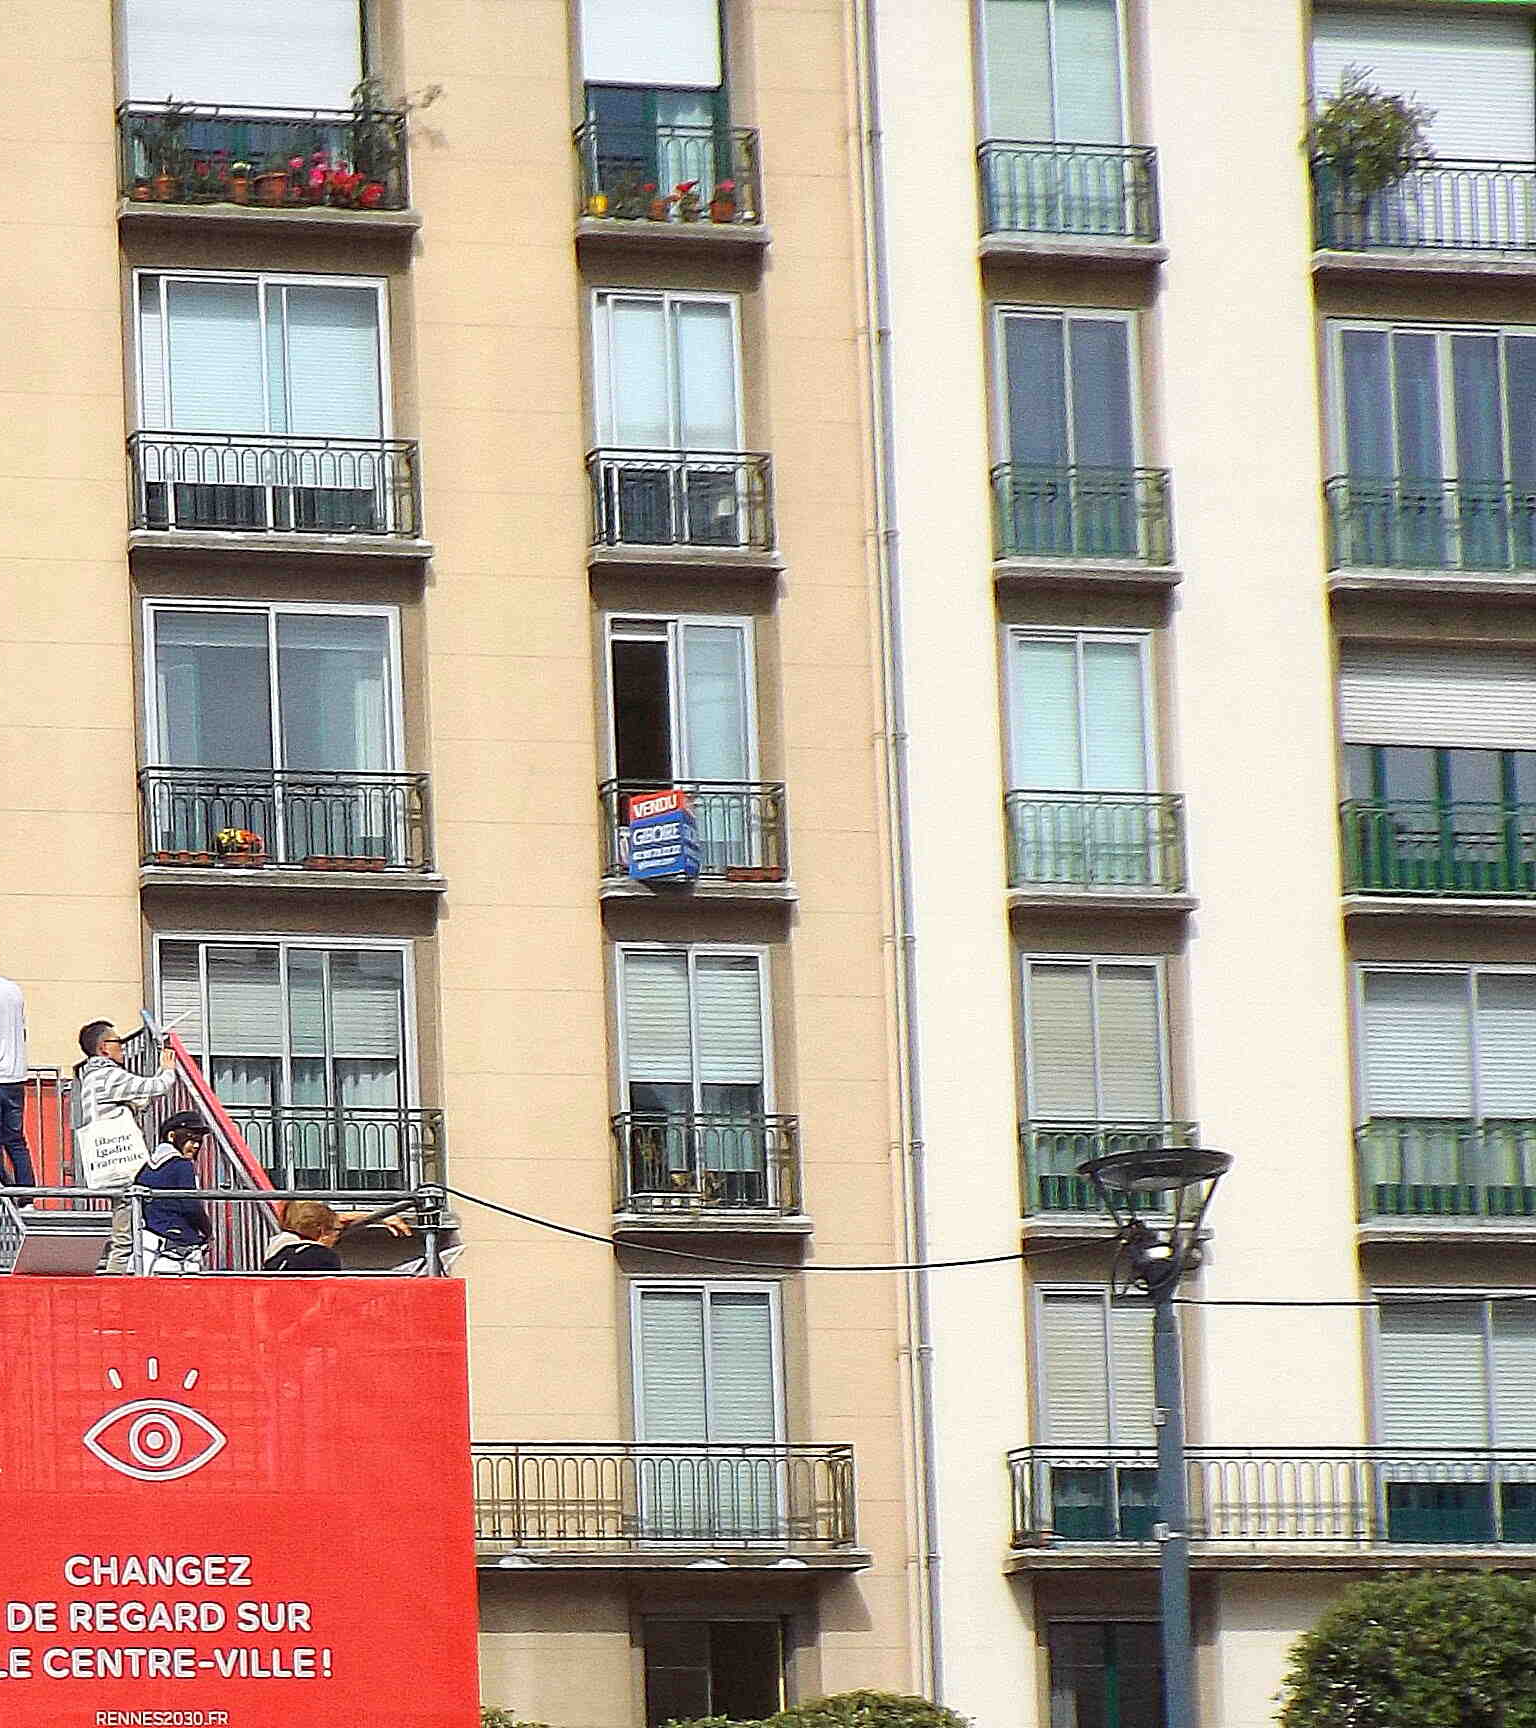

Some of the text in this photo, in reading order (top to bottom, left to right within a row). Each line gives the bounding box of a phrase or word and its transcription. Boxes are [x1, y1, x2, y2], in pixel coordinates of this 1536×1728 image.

[633, 794, 678, 818] VENDU
[64, 1556, 252, 1587] CHANGEZ
[6, 1602, 312, 1633] DE REGARD SUR
[95, 1711, 229, 1727] RENNES2030.FR
